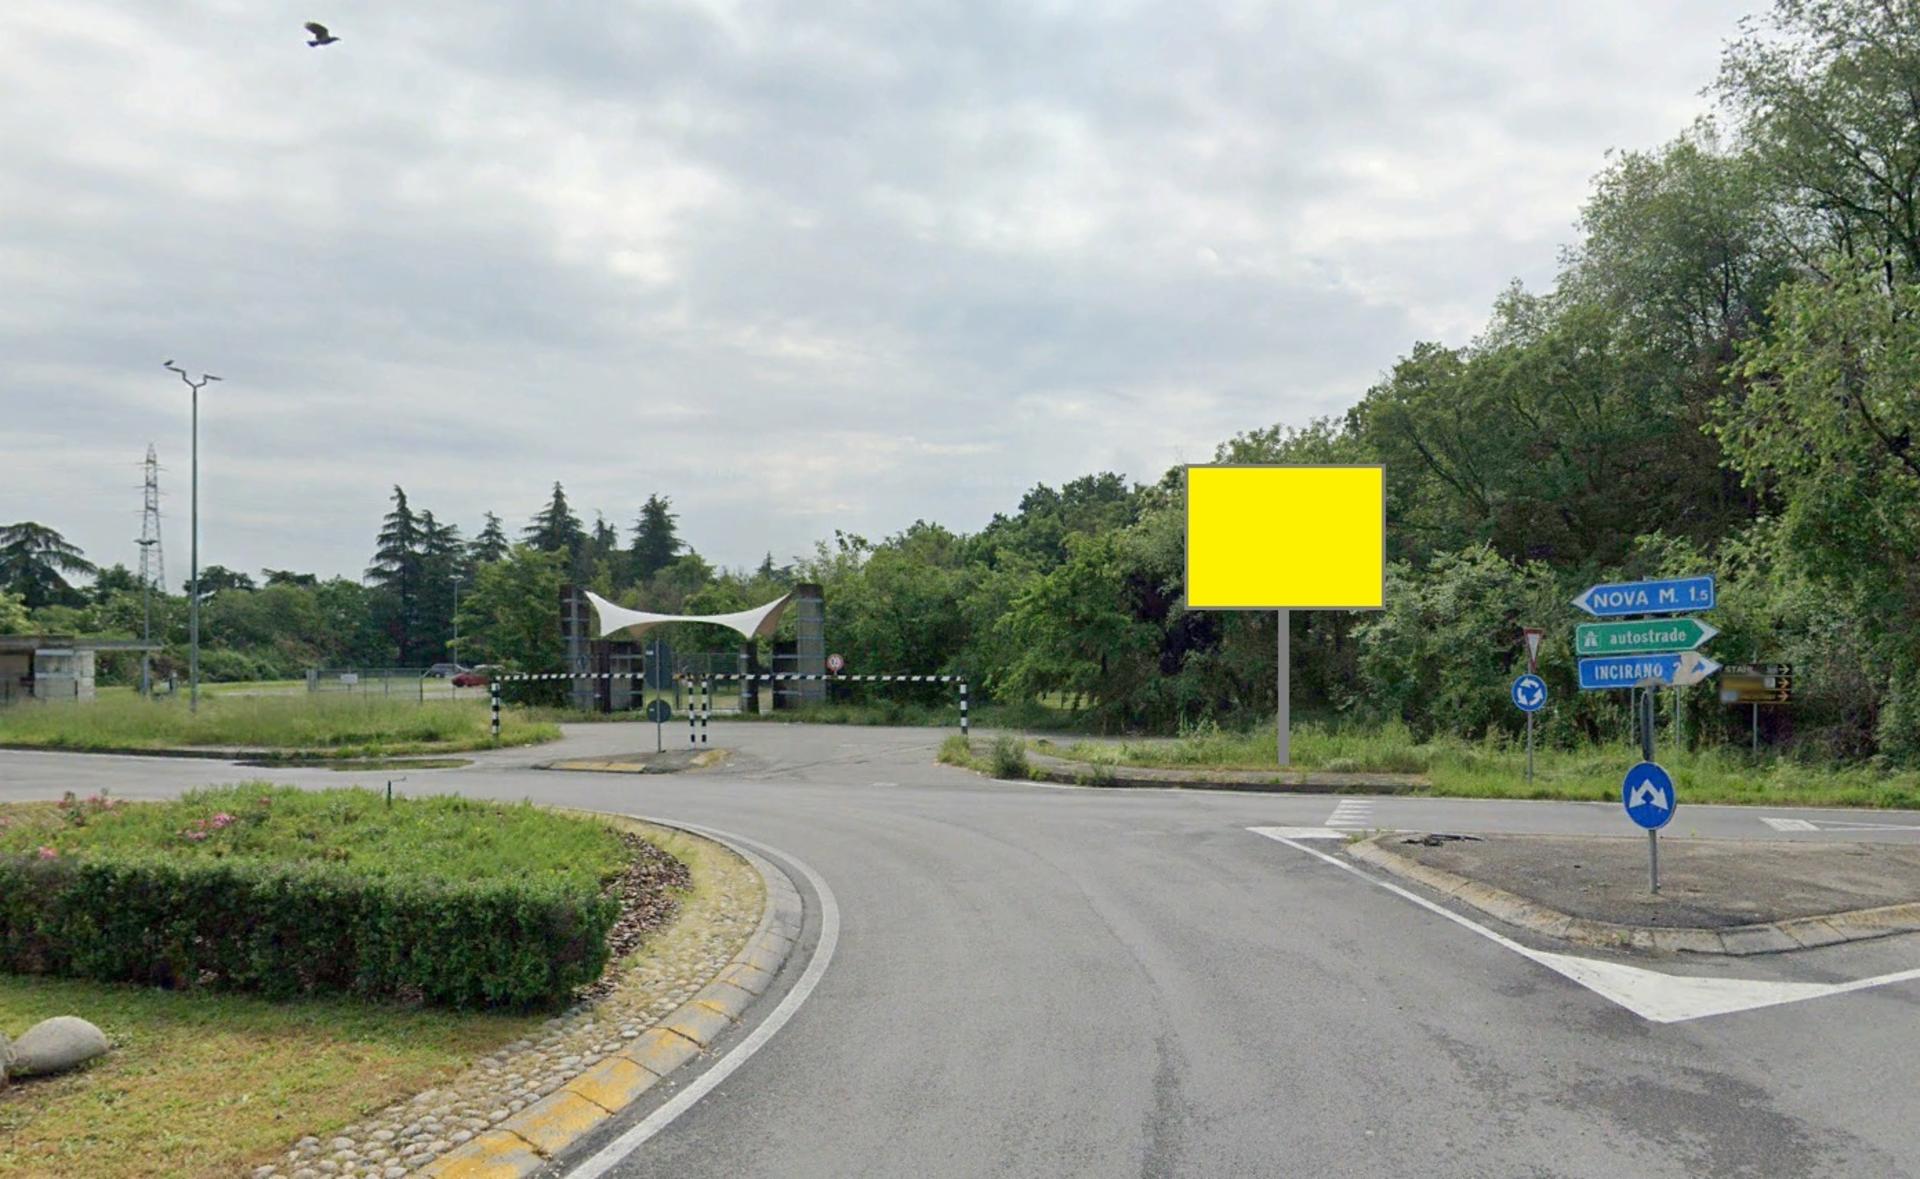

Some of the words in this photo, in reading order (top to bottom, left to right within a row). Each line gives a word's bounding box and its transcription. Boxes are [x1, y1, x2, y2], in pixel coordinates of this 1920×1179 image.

[1593, 591, 1648, 609] NOVA
[1659, 588, 1679, 604] M.
[1610, 627, 1687, 645] autostrade
[1595, 663, 1663, 680] INCIRANO
